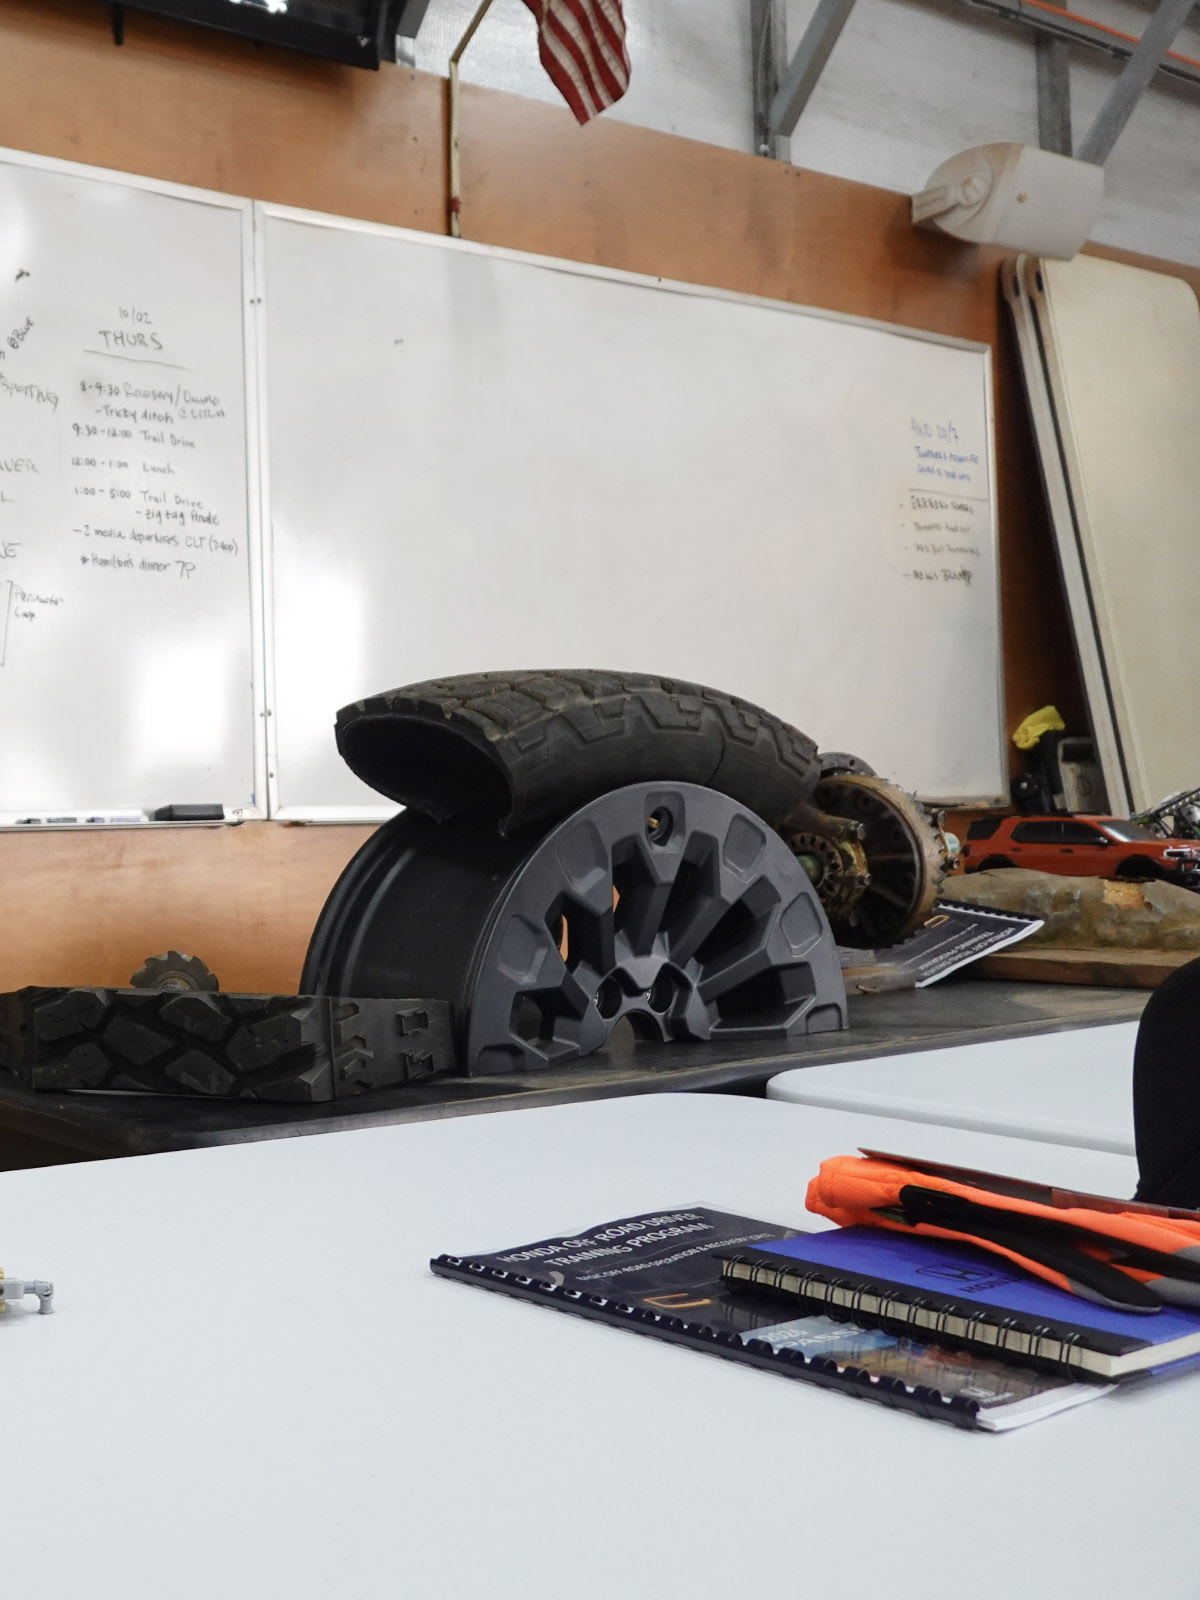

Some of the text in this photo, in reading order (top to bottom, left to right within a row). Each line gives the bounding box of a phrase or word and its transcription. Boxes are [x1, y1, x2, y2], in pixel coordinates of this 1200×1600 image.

[98, 330, 163, 350] THURS
[594, 1222, 646, 1242] ROAD
[625, 1222, 714, 1248] PROGRAM
